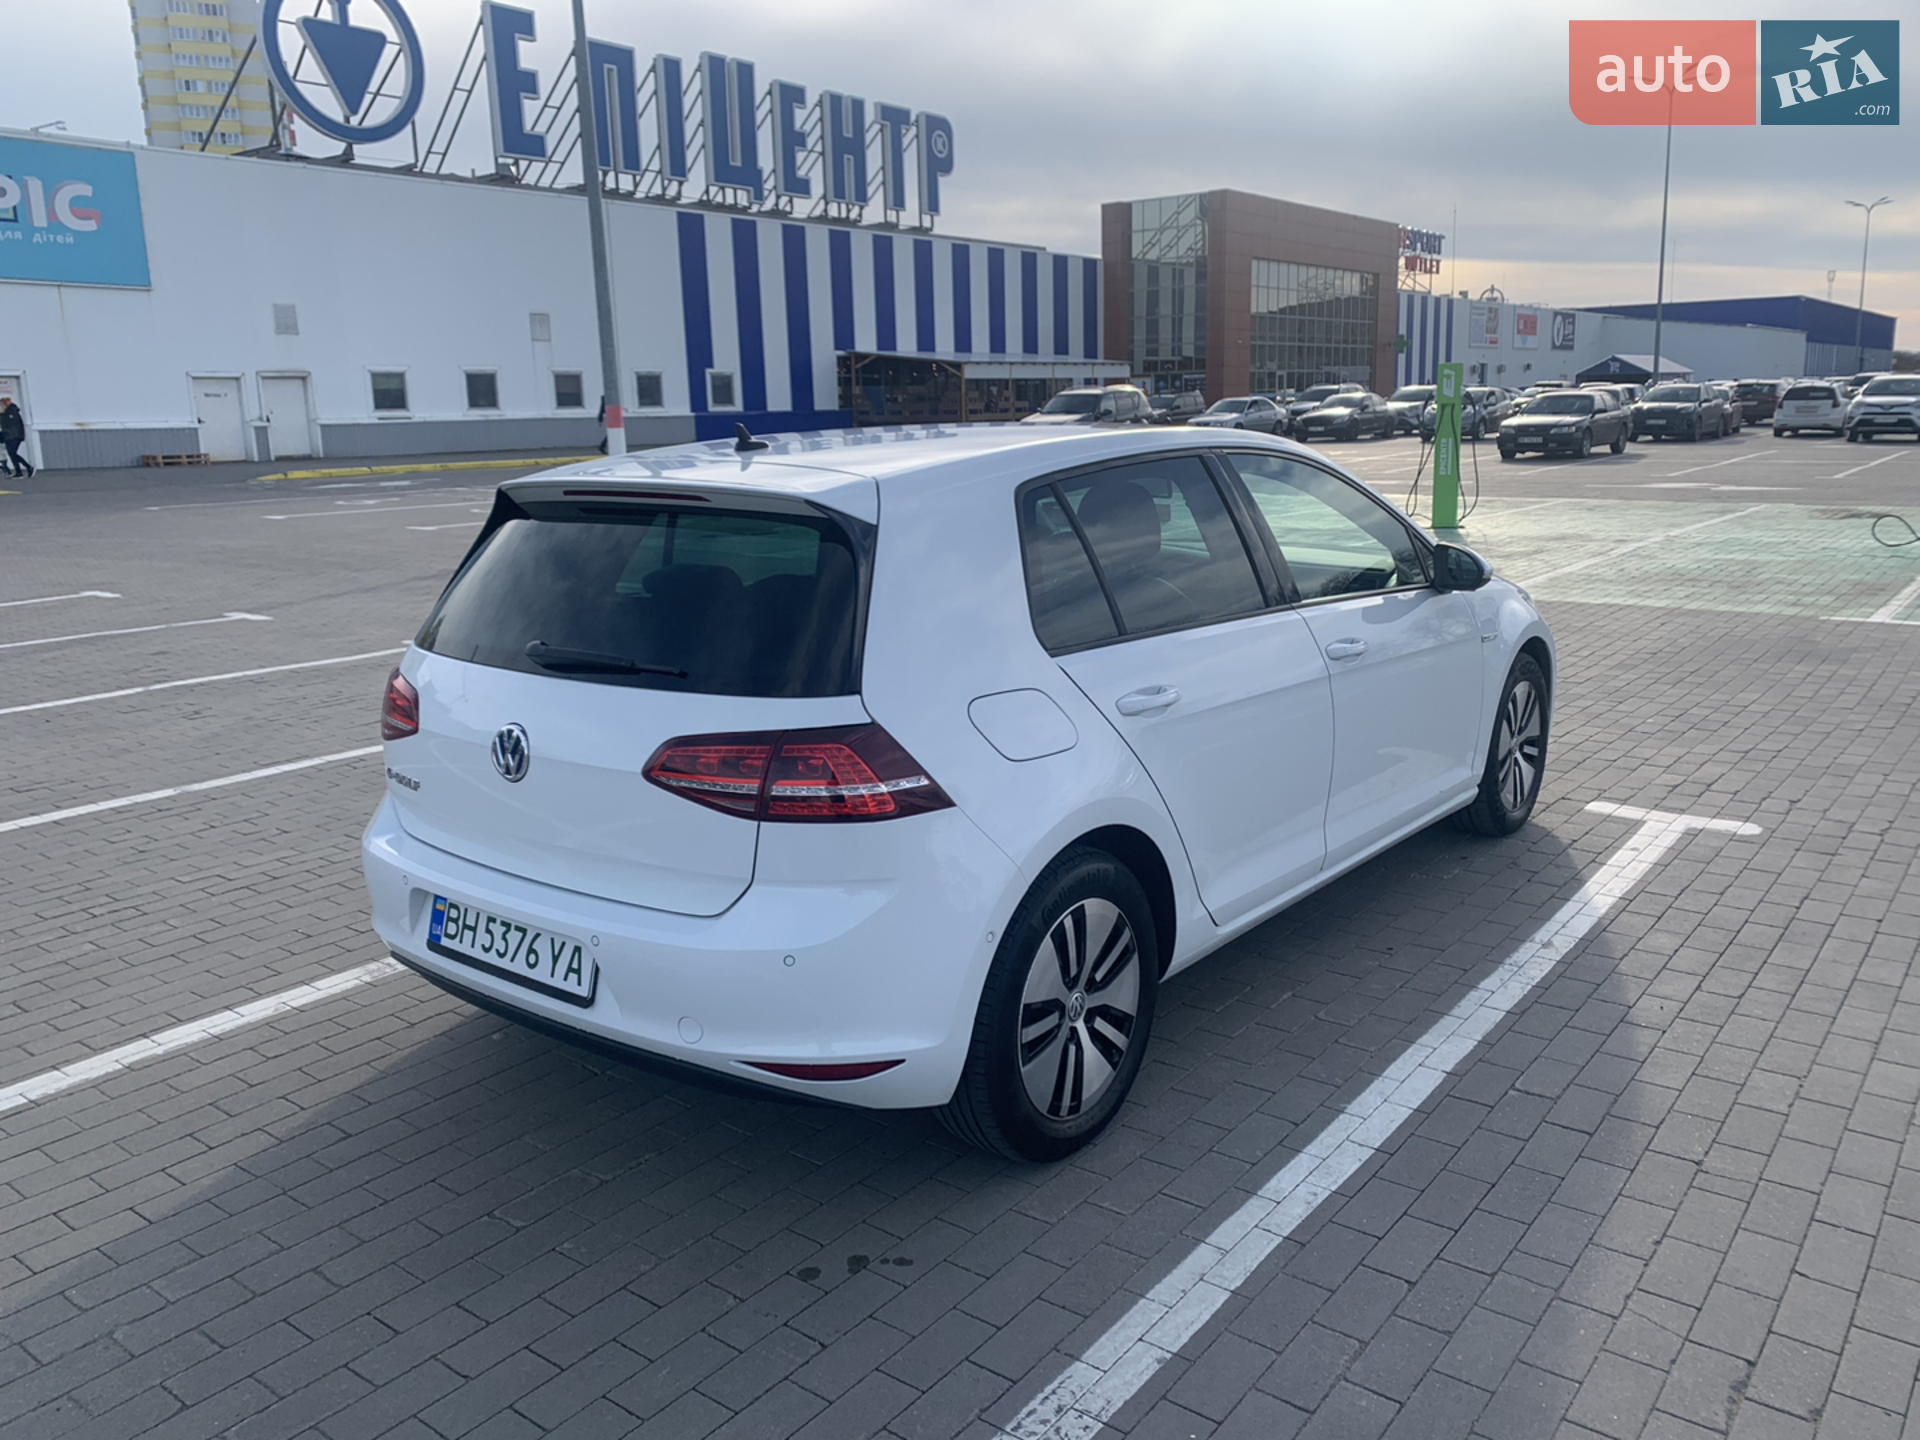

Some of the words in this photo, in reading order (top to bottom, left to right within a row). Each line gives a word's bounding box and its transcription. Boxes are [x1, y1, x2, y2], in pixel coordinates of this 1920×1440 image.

[481, 0, 955, 217] ЕПІЦЕНТР
[32, 231, 75, 244] дітей
[1439, 437, 1448, 475] EPICENTR
[432, 922, 442, 936] UA
[443, 902, 480, 949] BH
[481, 915, 542, 970] 5376
[551, 937, 582, 987] YA
